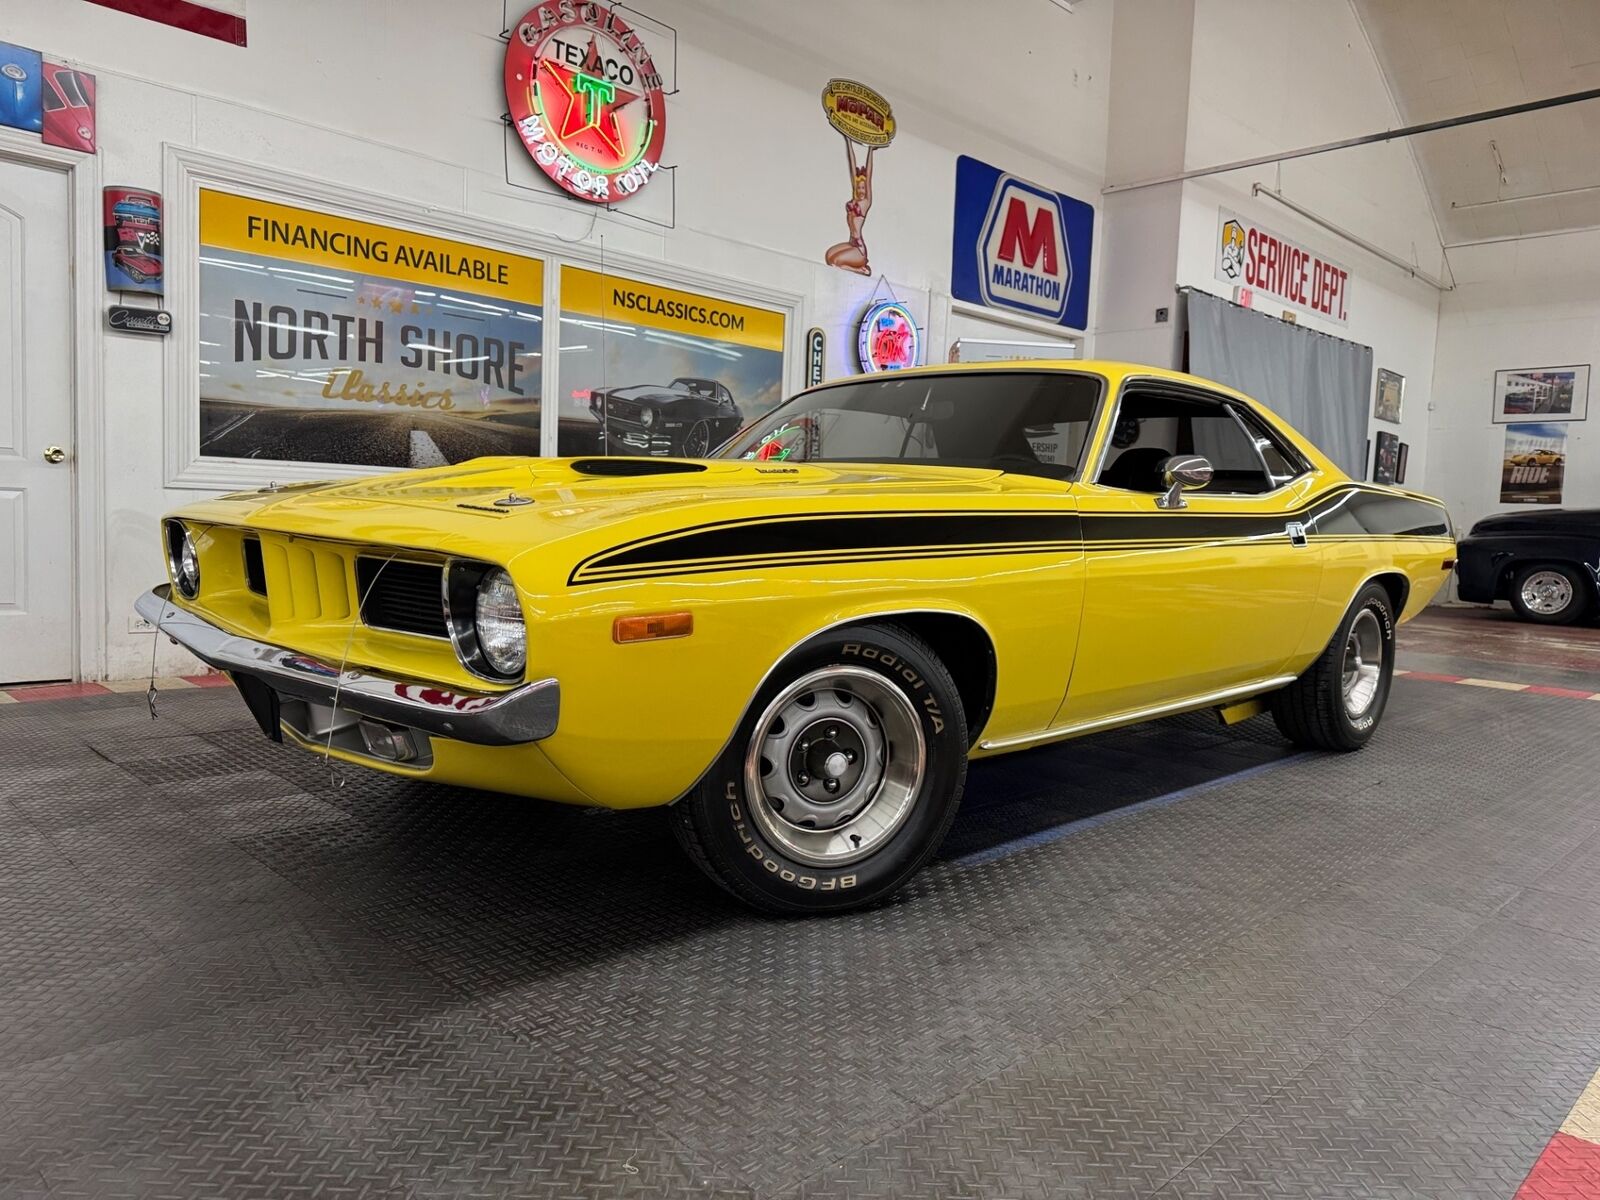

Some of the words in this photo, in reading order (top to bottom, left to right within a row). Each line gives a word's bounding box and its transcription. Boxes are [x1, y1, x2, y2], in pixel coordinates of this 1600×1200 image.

[552, 38, 634, 86] TEXACO
[576, 72, 615, 127] T
[836, 95, 885, 132] MOPAR
[519, 115, 609, 200] MOTOR
[615, 159, 659, 196] OIL
[247, 215, 389, 264] FINANCING
[394, 244, 509, 285] AVAILABLE
[997, 196, 1058, 277] M
[992, 263, 1061, 302] MARATHON
[1245, 227, 1310, 306] SERVICE
[1311, 257, 1348, 321] DEPT.
[612, 287, 745, 332] NSCLASSICS.COM
[234, 298, 384, 364] NORTH
[400, 324, 526, 396] SHORE
[321, 367, 456, 411] Classics
[1509, 466, 1551, 484] RIDE
[841, 643, 924, 691] Radial
[922, 691, 945, 736] T/A
[725, 781, 857, 891] BFGoodrich
